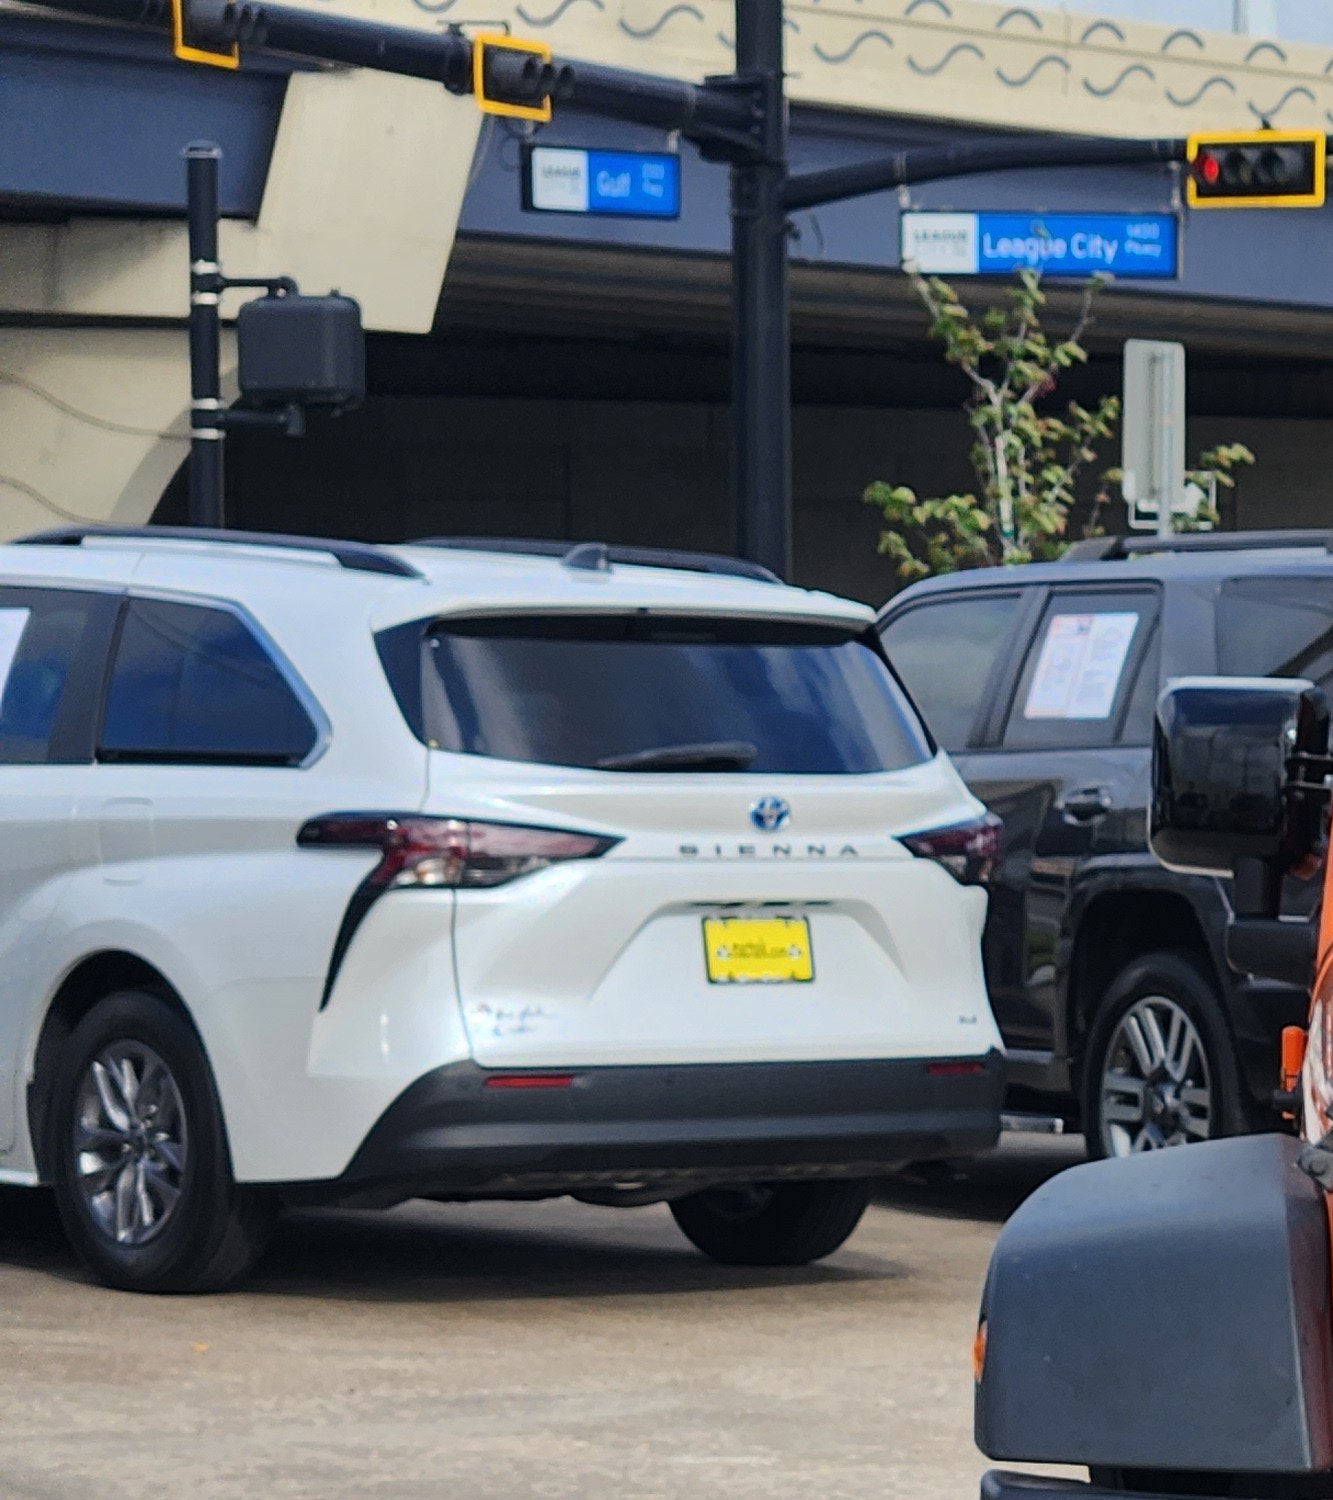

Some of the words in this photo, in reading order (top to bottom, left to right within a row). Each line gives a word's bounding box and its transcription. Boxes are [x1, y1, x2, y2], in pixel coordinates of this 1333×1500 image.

[982, 232, 1067, 265] League
[1070, 232, 1118, 264] City
[678, 843, 859, 857] SIENNA
